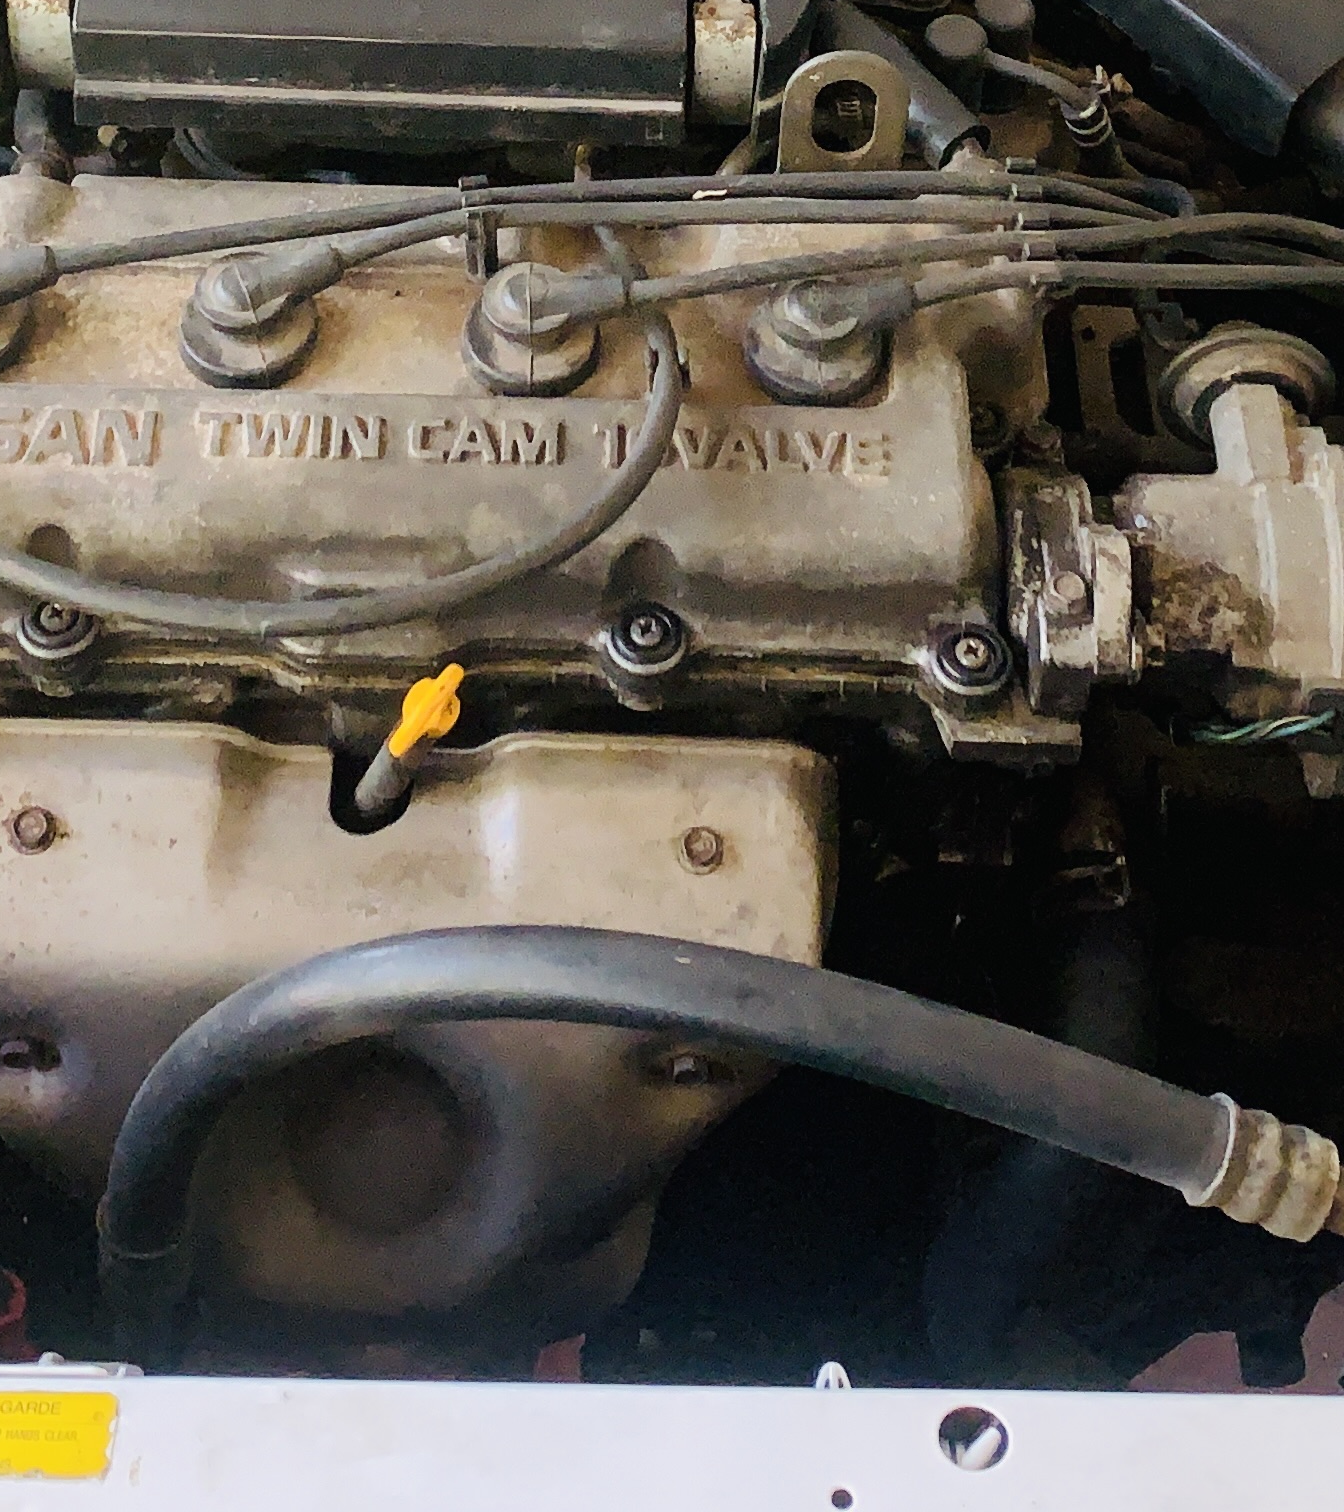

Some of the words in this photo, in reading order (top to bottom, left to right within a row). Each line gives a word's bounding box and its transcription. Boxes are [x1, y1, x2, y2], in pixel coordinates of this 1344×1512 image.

[193, 410, 388, 460] TWIN
[407, 415, 564, 466] CAM
[0, 1399, 62, 1416] GARDE
